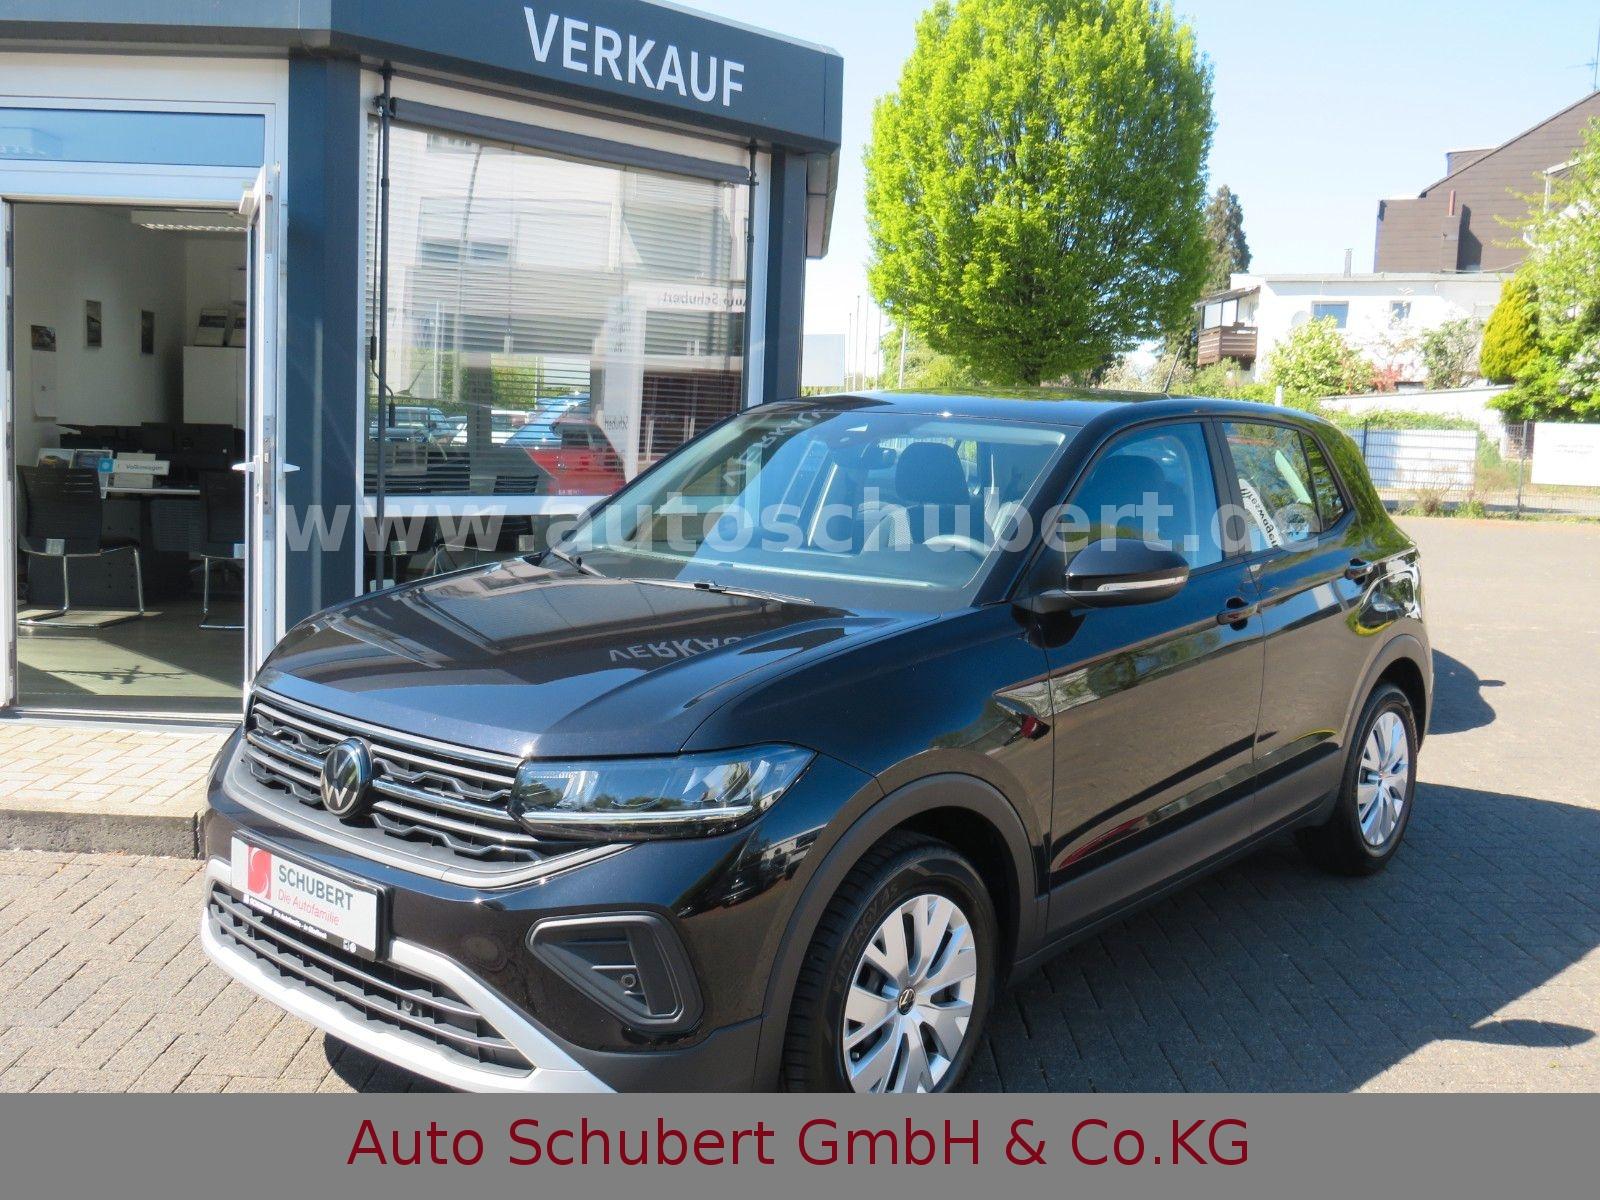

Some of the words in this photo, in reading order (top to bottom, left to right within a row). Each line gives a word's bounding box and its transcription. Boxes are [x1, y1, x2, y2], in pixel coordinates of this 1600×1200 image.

[523, 6, 745, 107] VERKAUF
[278, 864, 353, 911] SCHUBERT
[278, 889, 292, 904] Die
[292, 895, 340, 926] Autofamilie
